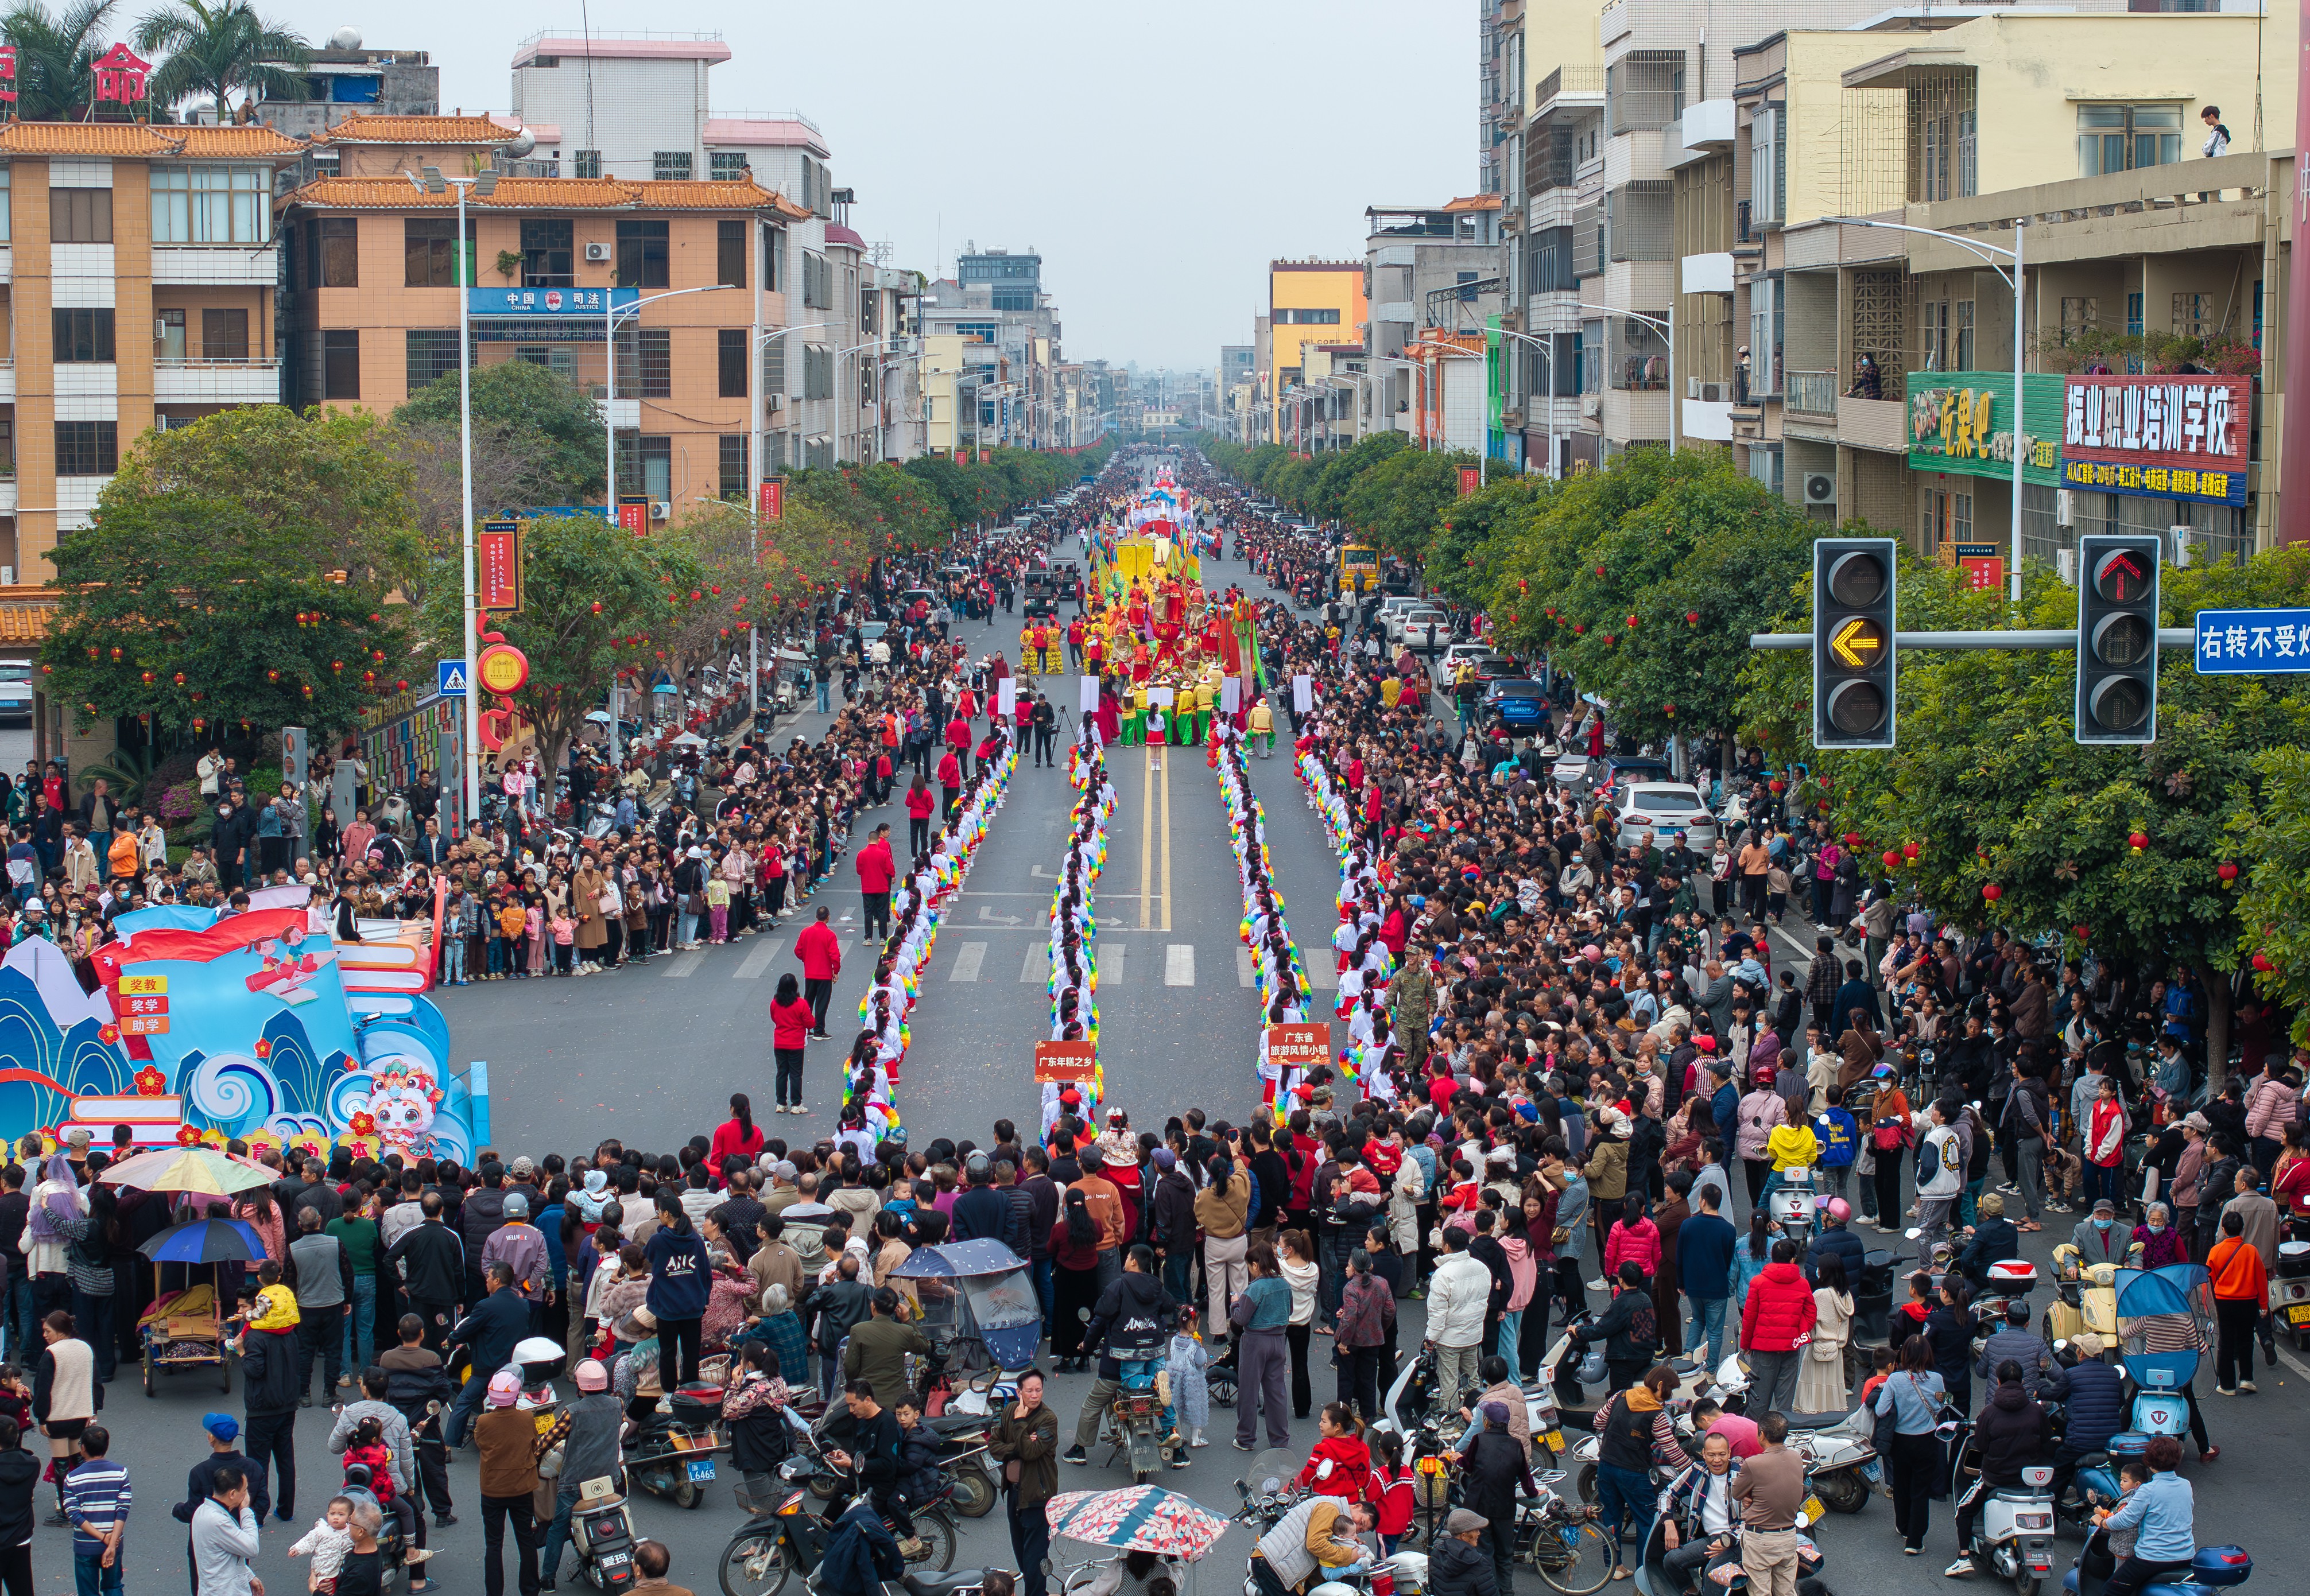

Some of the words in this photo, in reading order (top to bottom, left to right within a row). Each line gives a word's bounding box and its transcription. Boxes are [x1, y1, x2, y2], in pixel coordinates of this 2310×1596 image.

[507, 293, 534, 305] 中国
[573, 293, 599, 304] 司法
[1940, 387, 1993, 459] 吃果吧
[2067, 384, 2228, 455] 振业职业培训学校
[130, 978, 157, 991] 奖教
[131, 999, 158, 1012] 奖学
[132, 1019, 159, 1032] 助学
[1285, 1032, 1313, 1043] 广东省
[1270, 1044, 1328, 1056] 旅游风情小镇
[1038, 1056, 1092, 1067] 广东年糕之乡
[690, 1469, 715, 1481] L6465
